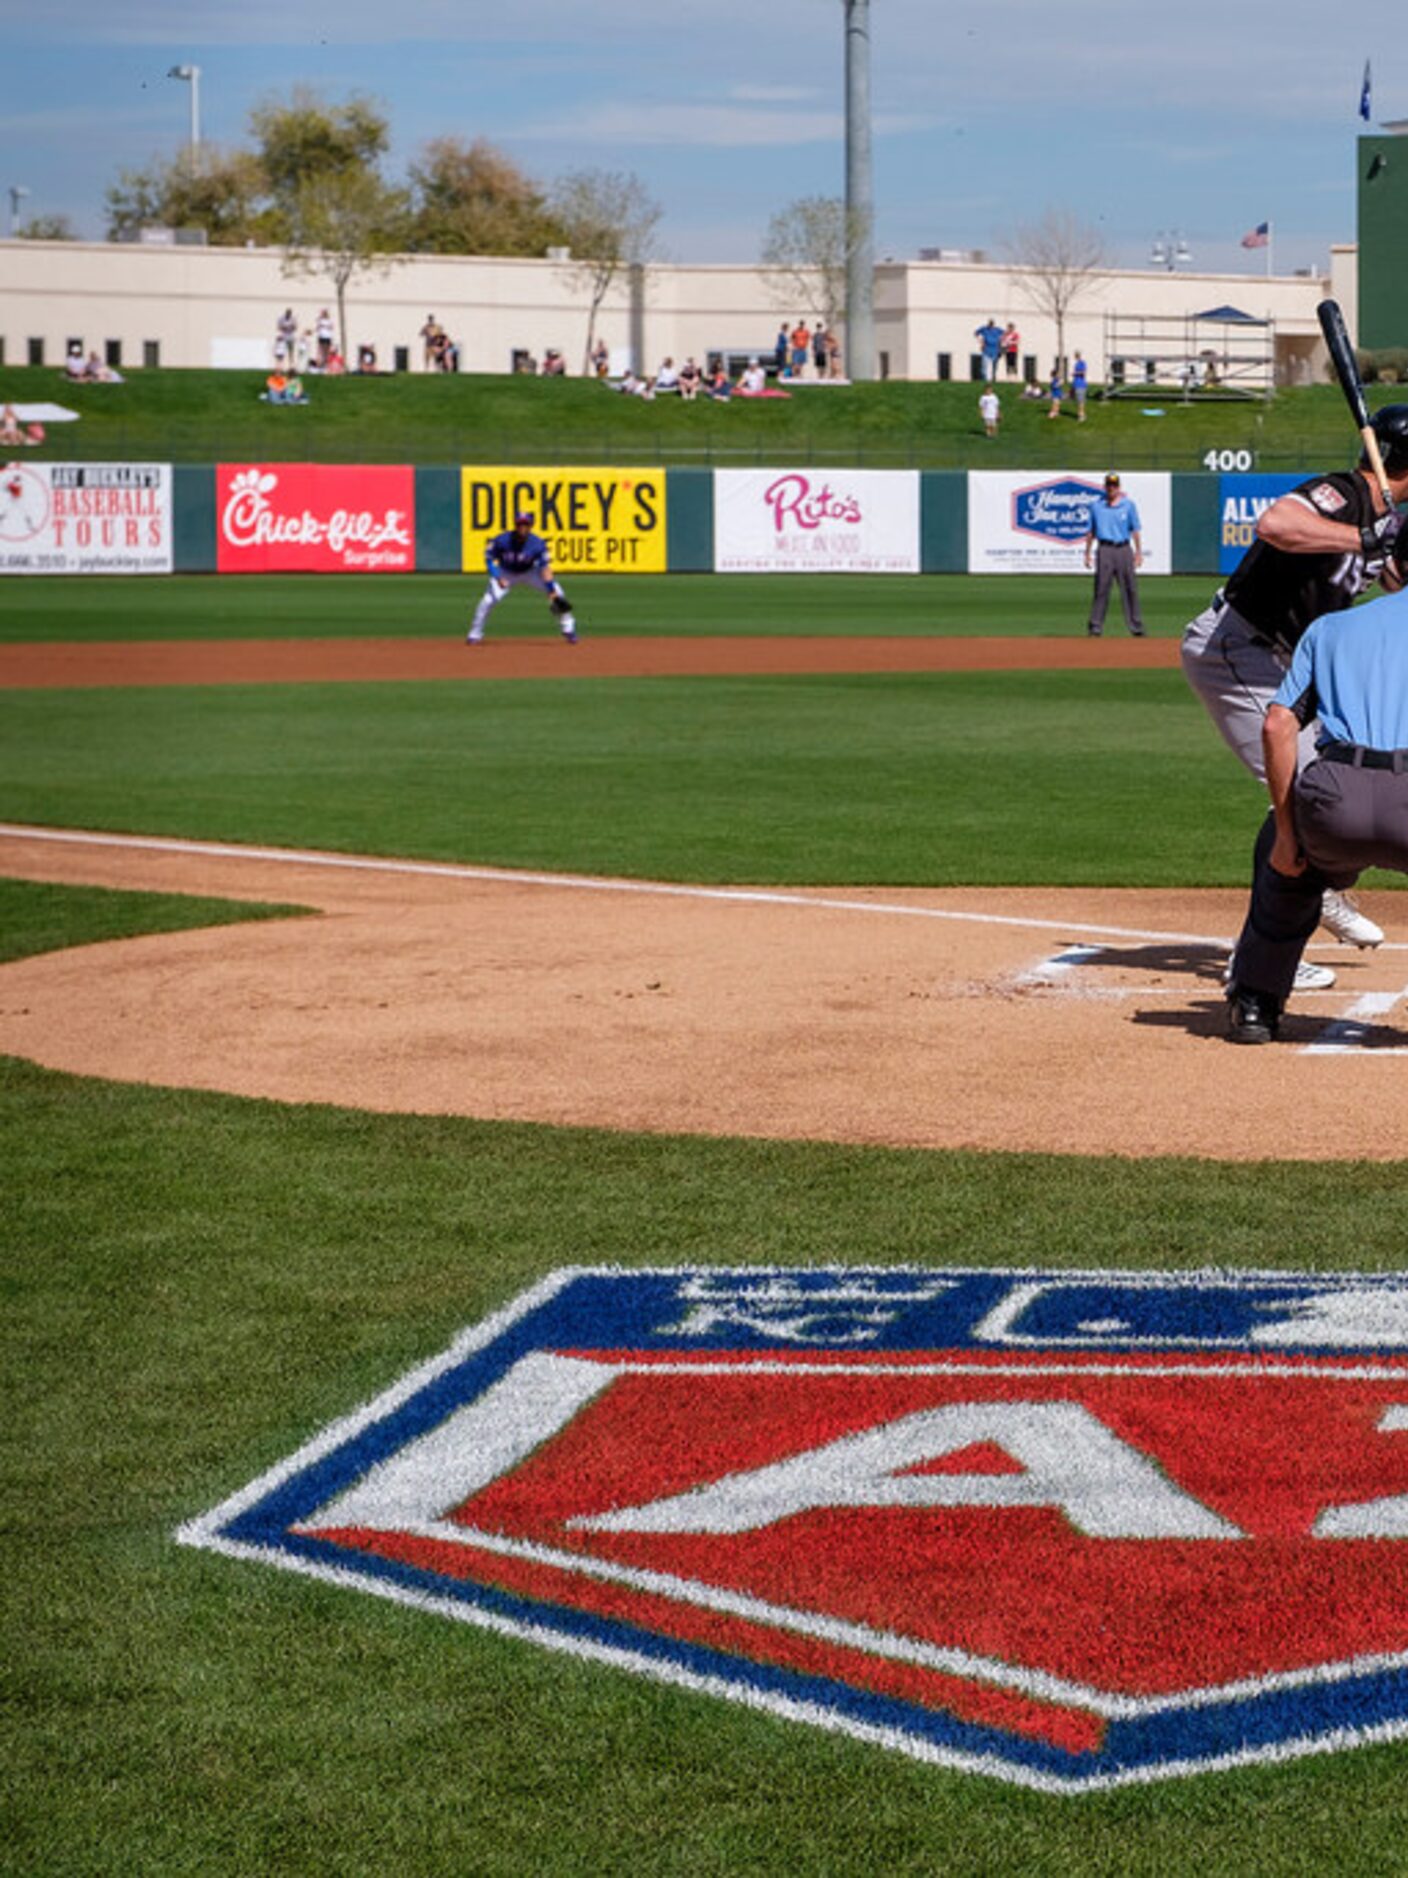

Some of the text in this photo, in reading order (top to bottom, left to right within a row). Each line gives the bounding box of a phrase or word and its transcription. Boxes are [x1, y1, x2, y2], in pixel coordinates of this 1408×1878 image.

[1203, 450, 1252, 471] 400
[53, 488, 160, 515] BASEBALL
[471, 482, 657, 531] DICKEY'S
[764, 474, 862, 533] Rito's
[1223, 497, 1277, 521] ALW
[53, 519, 160, 547] TOURS
[223, 488, 410, 552] Chick-fil-A
[343, 549, 407, 568] Surprise
[606, 538, 639, 563] PIT
